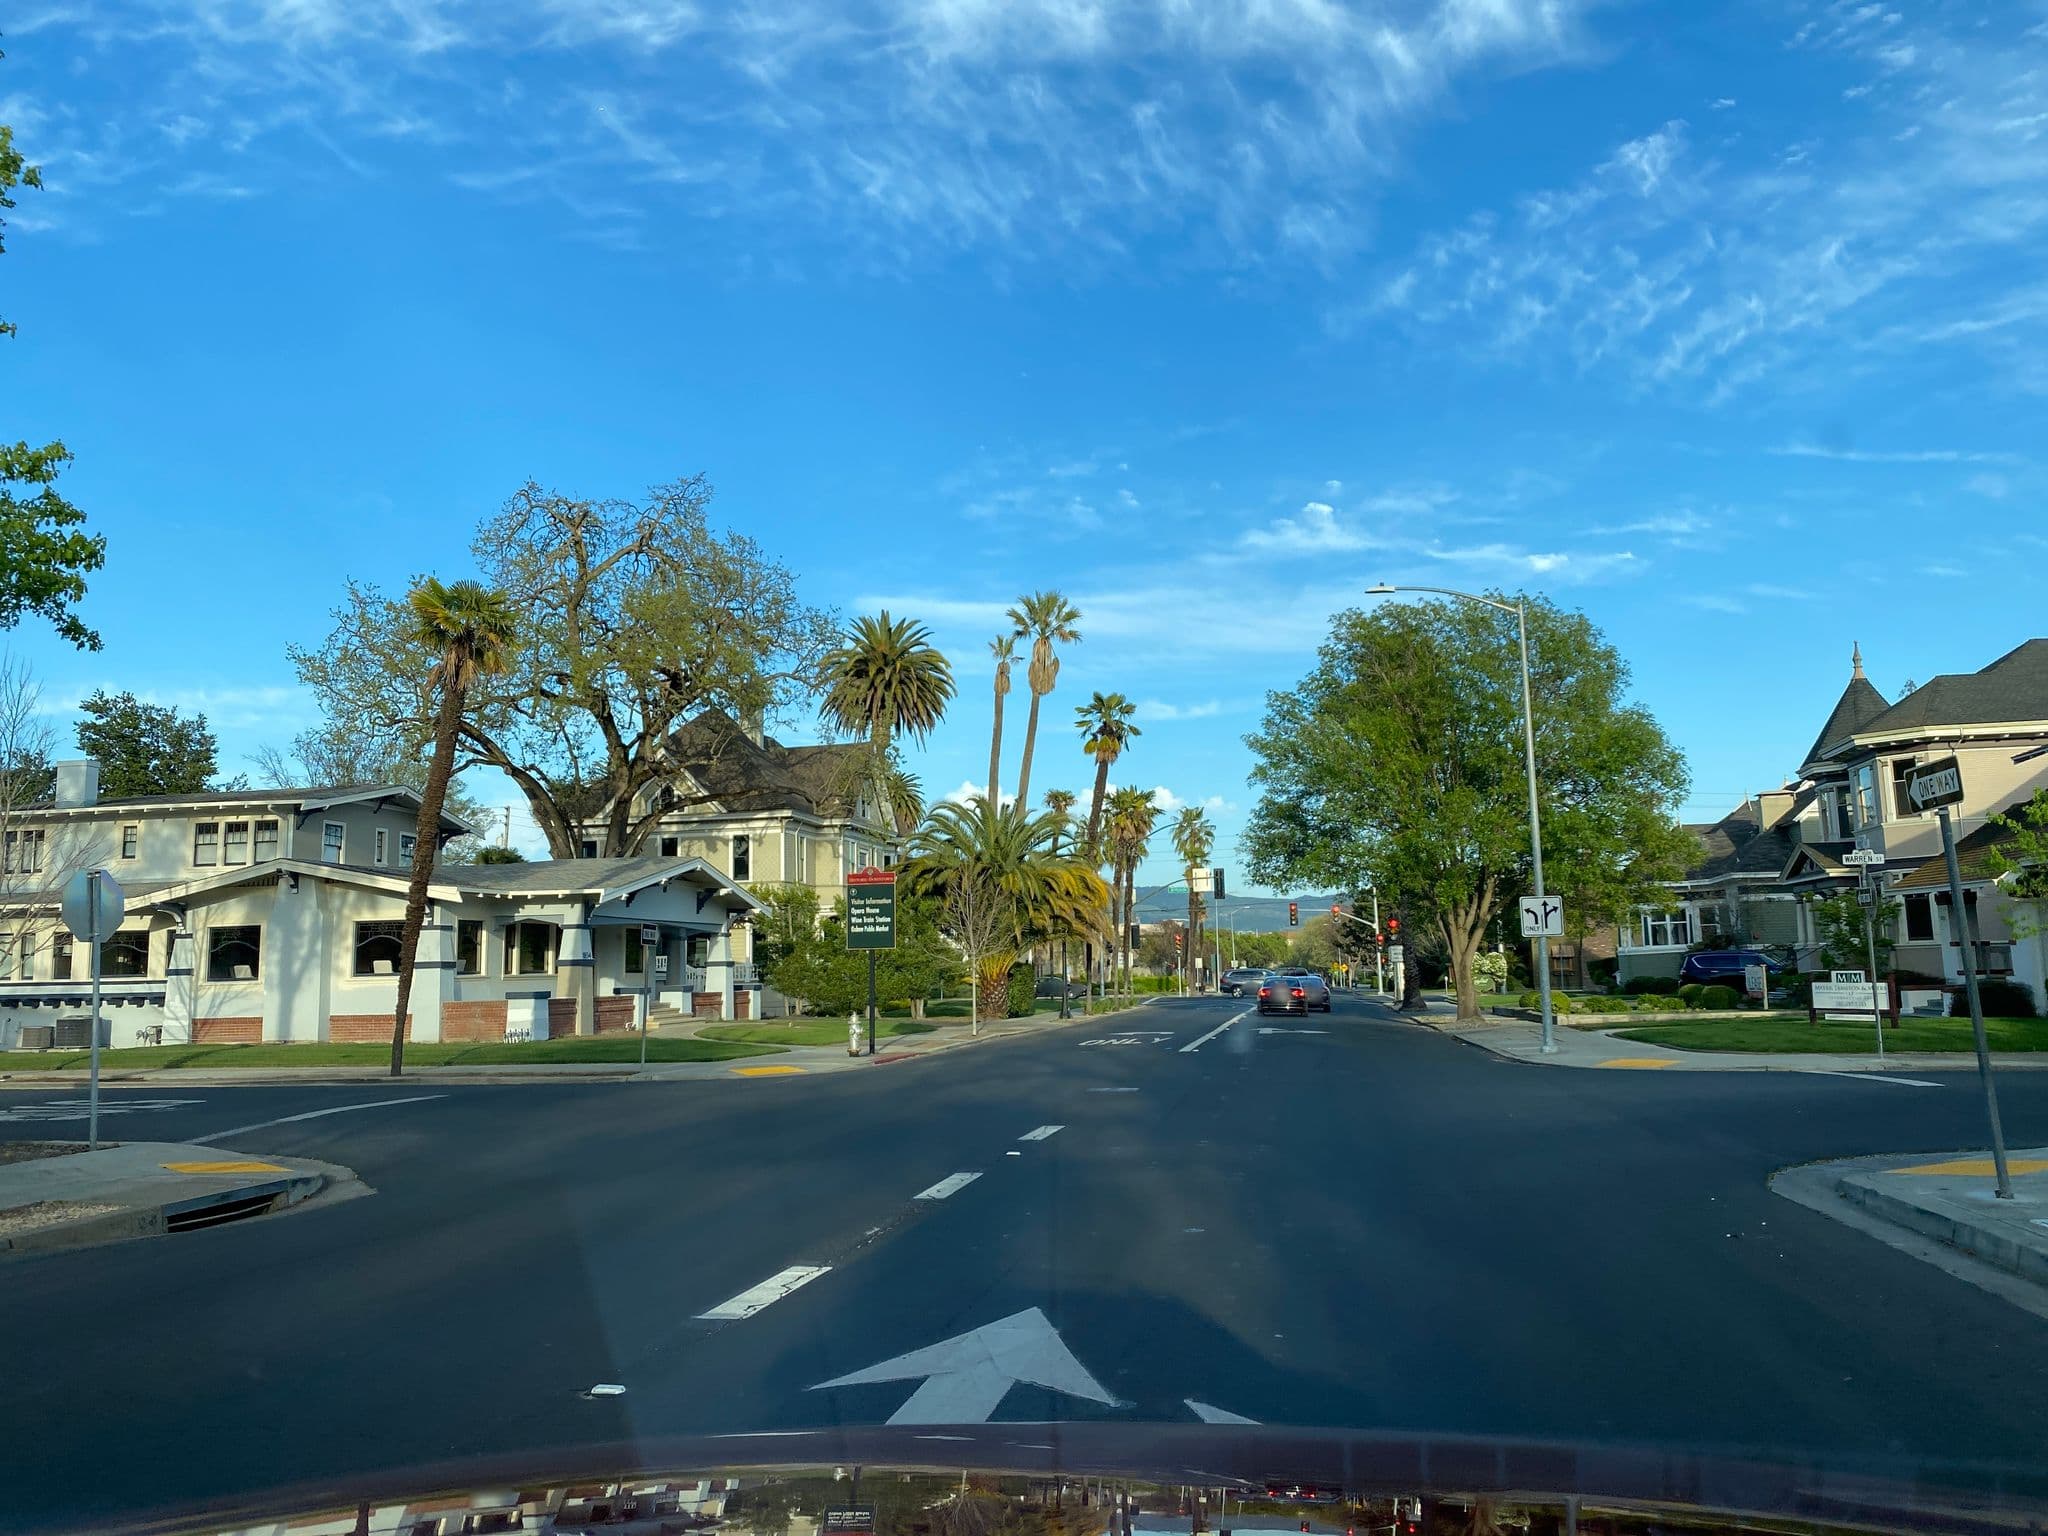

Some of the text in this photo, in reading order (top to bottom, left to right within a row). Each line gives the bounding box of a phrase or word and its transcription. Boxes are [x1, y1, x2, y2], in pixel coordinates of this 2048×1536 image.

[1919, 771, 1956, 798] ONE WAY
[1844, 855, 1873, 863] WARREN
[866, 897, 892, 905] Information
[851, 907, 865, 915] Opera
[1077, 1036, 1172, 1046] ONLY
